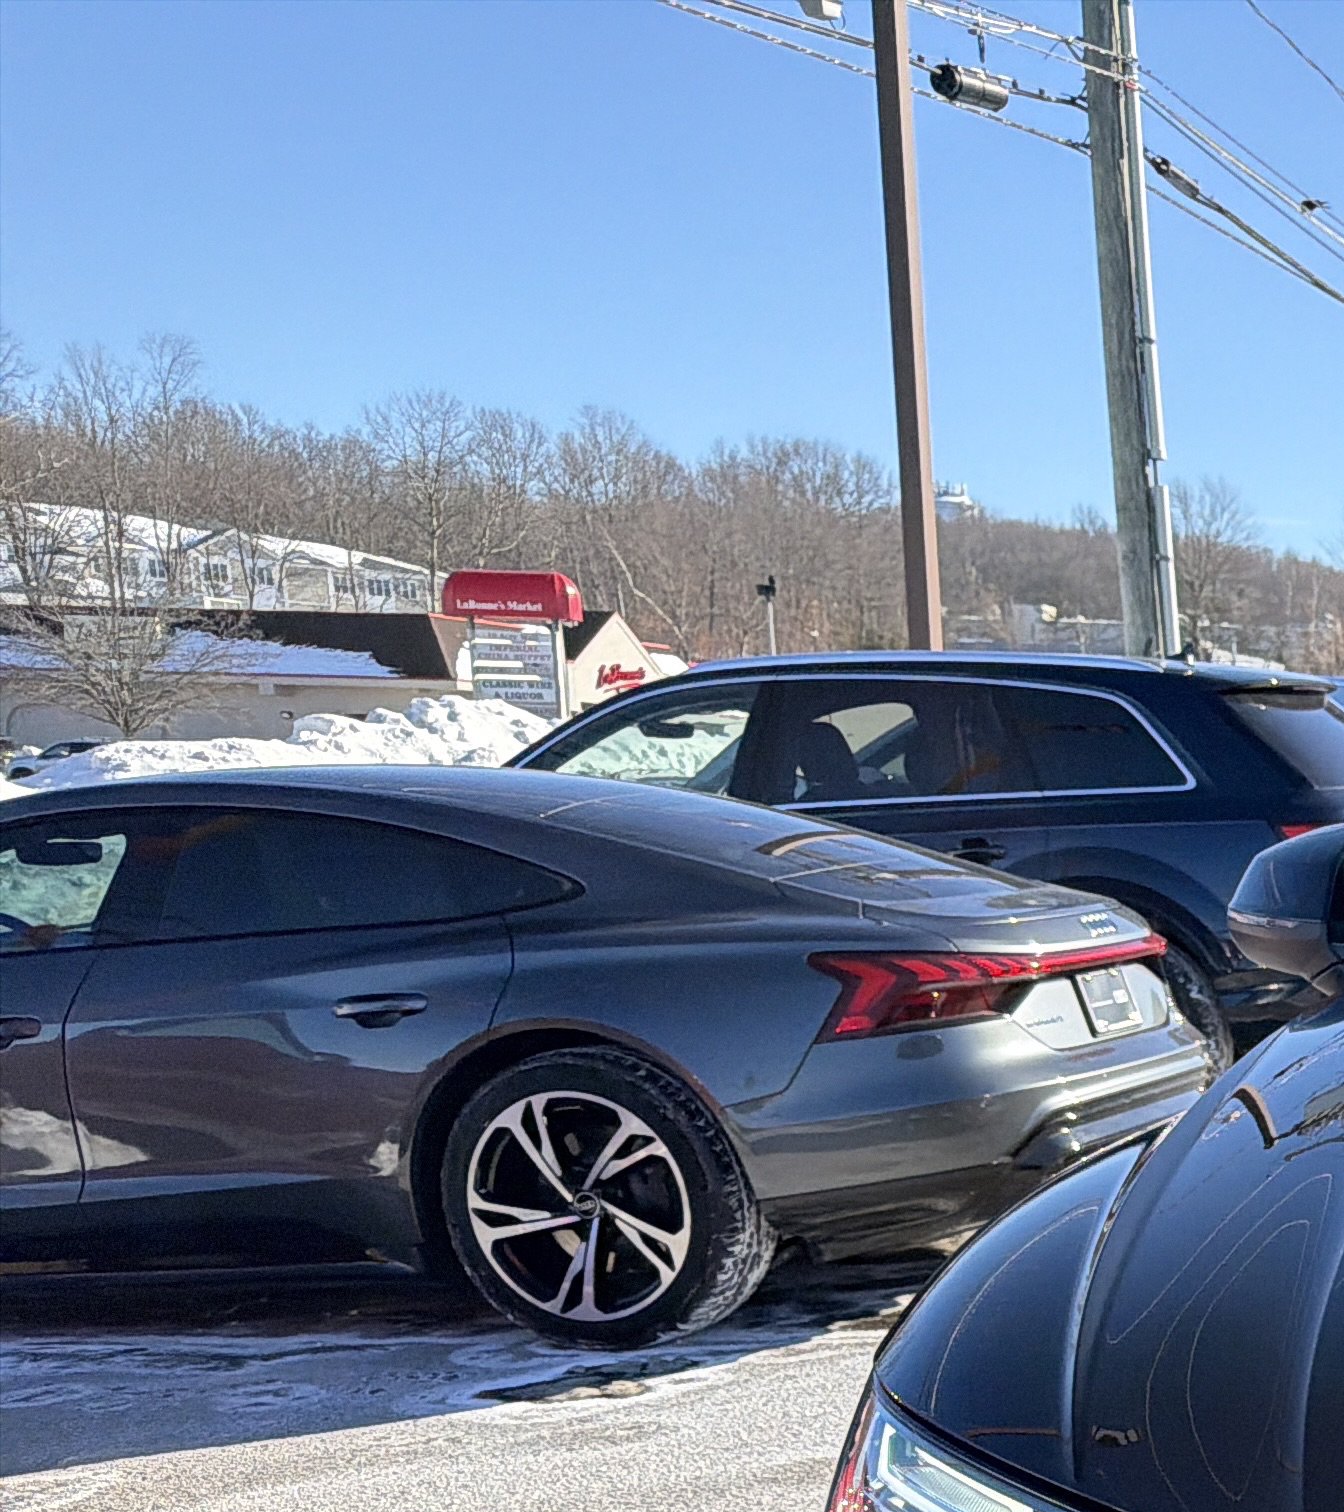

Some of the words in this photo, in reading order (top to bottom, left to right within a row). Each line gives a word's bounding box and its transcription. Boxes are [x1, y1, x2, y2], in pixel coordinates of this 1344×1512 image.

[506, 600, 543, 612] Market
[482, 680, 524, 689] CLASSIC
[504, 691, 545, 701] LIQUOR
